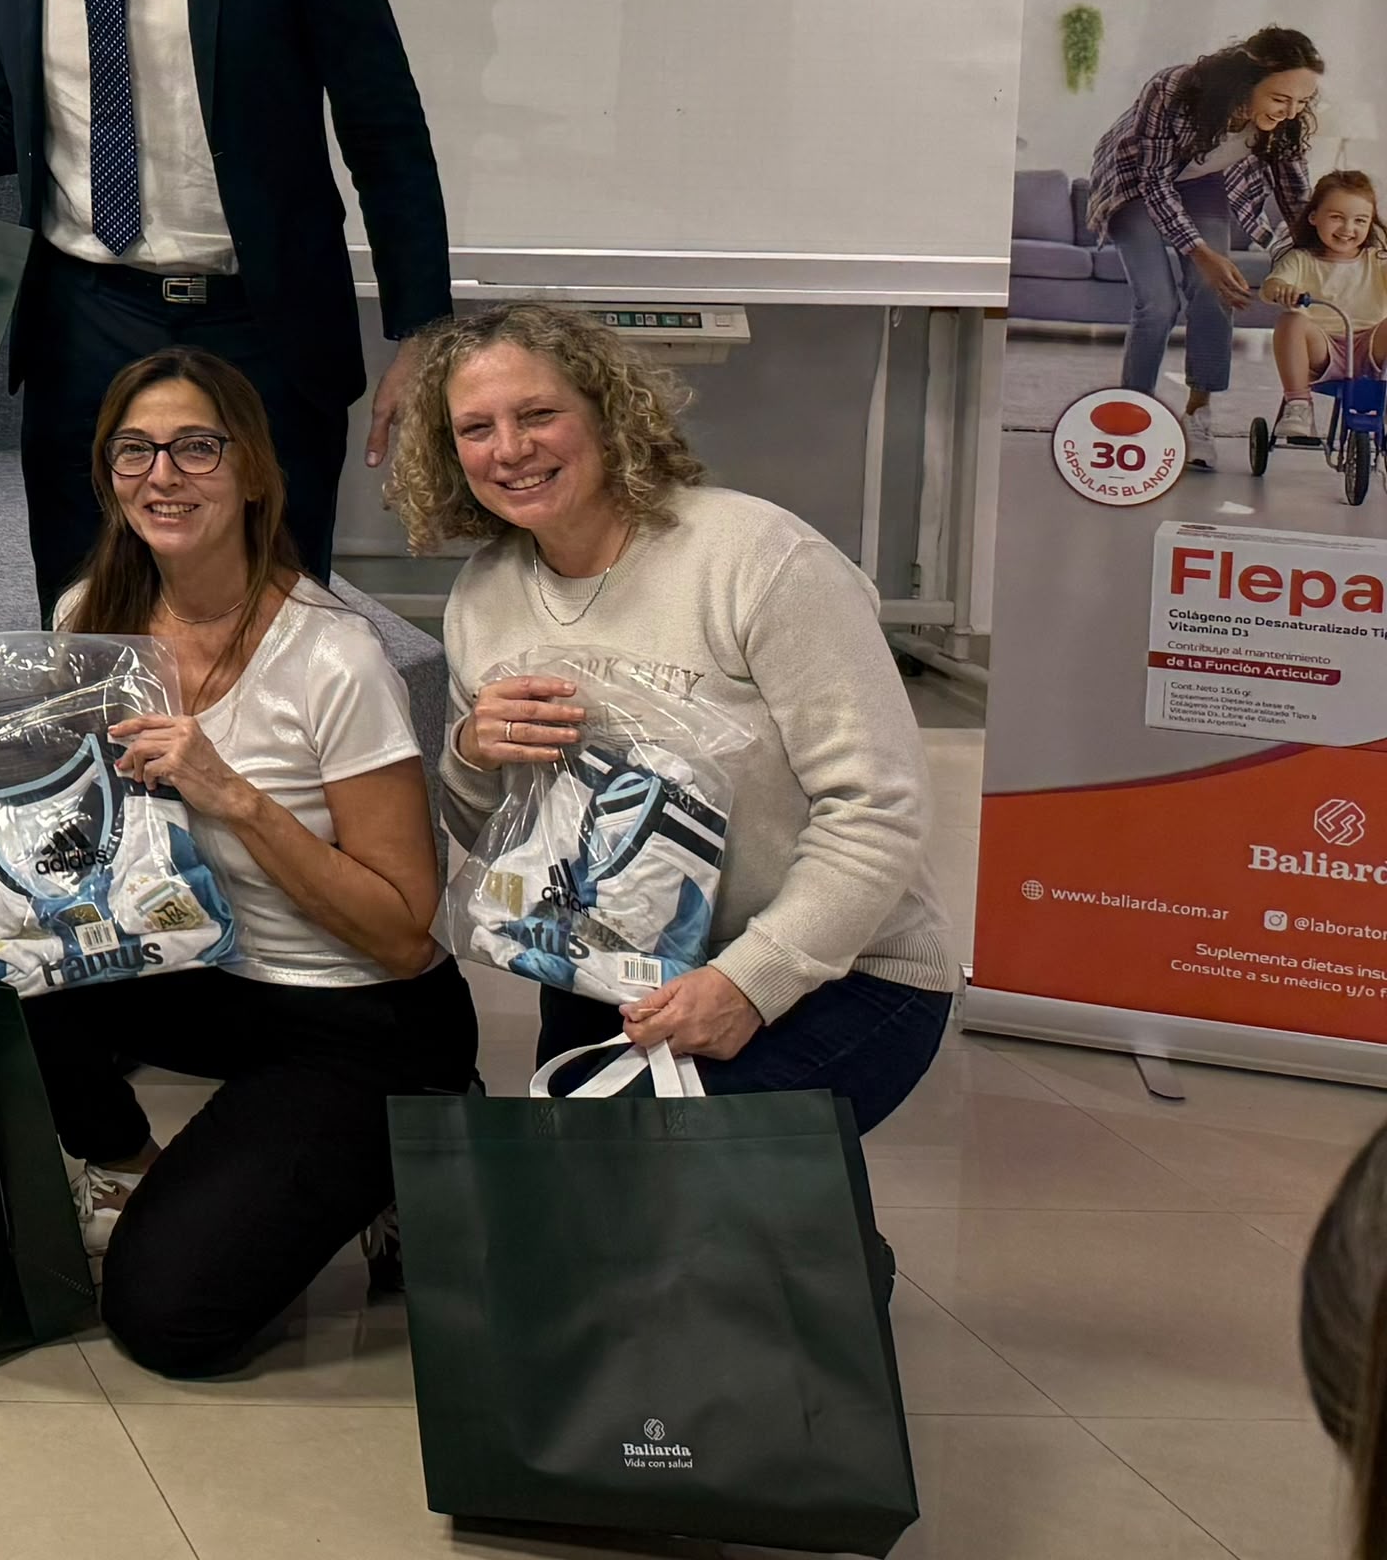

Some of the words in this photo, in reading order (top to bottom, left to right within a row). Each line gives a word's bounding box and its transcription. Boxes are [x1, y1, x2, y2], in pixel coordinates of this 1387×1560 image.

[1063, 440, 1119, 496] CÁPSULAS
[1122, 447, 1176, 496] BLANDAS
[1090, 441, 1146, 471] 30
[1170, 547, 1384, 616] Flepa
[1168, 622, 1228, 636] Vitamina
[1169, 609, 1231, 624] Colágeno
[1235, 616, 1251, 625] no
[1255, 616, 1368, 637] Desnaturalizado
[1371, 627, 1387, 640] Ti
[1168, 640, 1230, 656] Contribuye
[1232, 647, 1242, 656] al
[1245, 649, 1331, 665] mantenimiento
[1166, 656, 1185, 667] de
[1188, 658, 1202, 669] la
[1205, 660, 1260, 675] Función
[1264, 666, 1330, 682] Articular
[36, 848, 107, 876] adidas
[1051, 888, 1229, 920] www.baliarda.com.ar
[1195, 943, 1298, 968] Suplementa
[1301, 958, 1353, 976] dietas
[1171, 960, 1242, 979] Consulte
[1246, 971, 1256, 981] a
[1260, 973, 1280, 984] su
[1284, 975, 1342, 992] médico
[1346, 985, 1375, 998] y/o
[622, 1443, 692, 1456] Baliarda
[624, 1458, 646, 1468] Vida
[668, 1458, 693, 1469] salud
